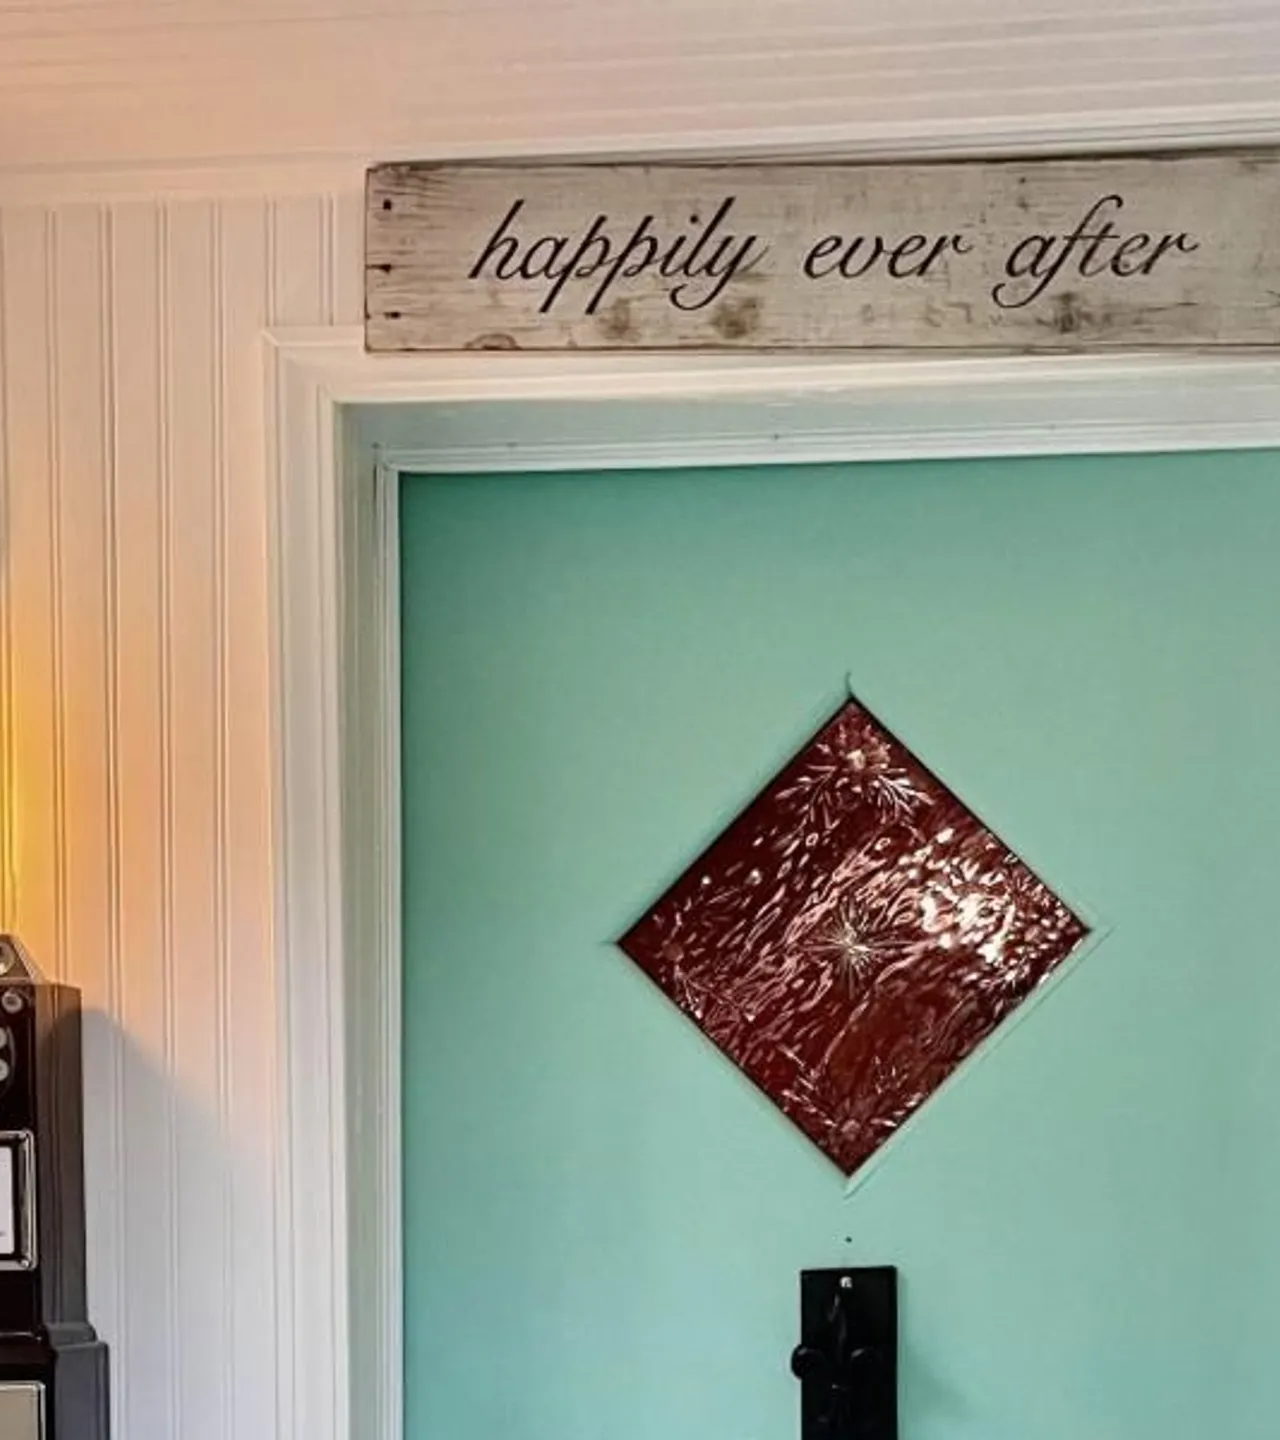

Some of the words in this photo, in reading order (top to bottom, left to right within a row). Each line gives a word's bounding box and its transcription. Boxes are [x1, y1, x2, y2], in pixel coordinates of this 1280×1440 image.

[468, 195, 762, 315] happily
[803, 234, 972, 280] ever
[991, 194, 1200, 309] after
